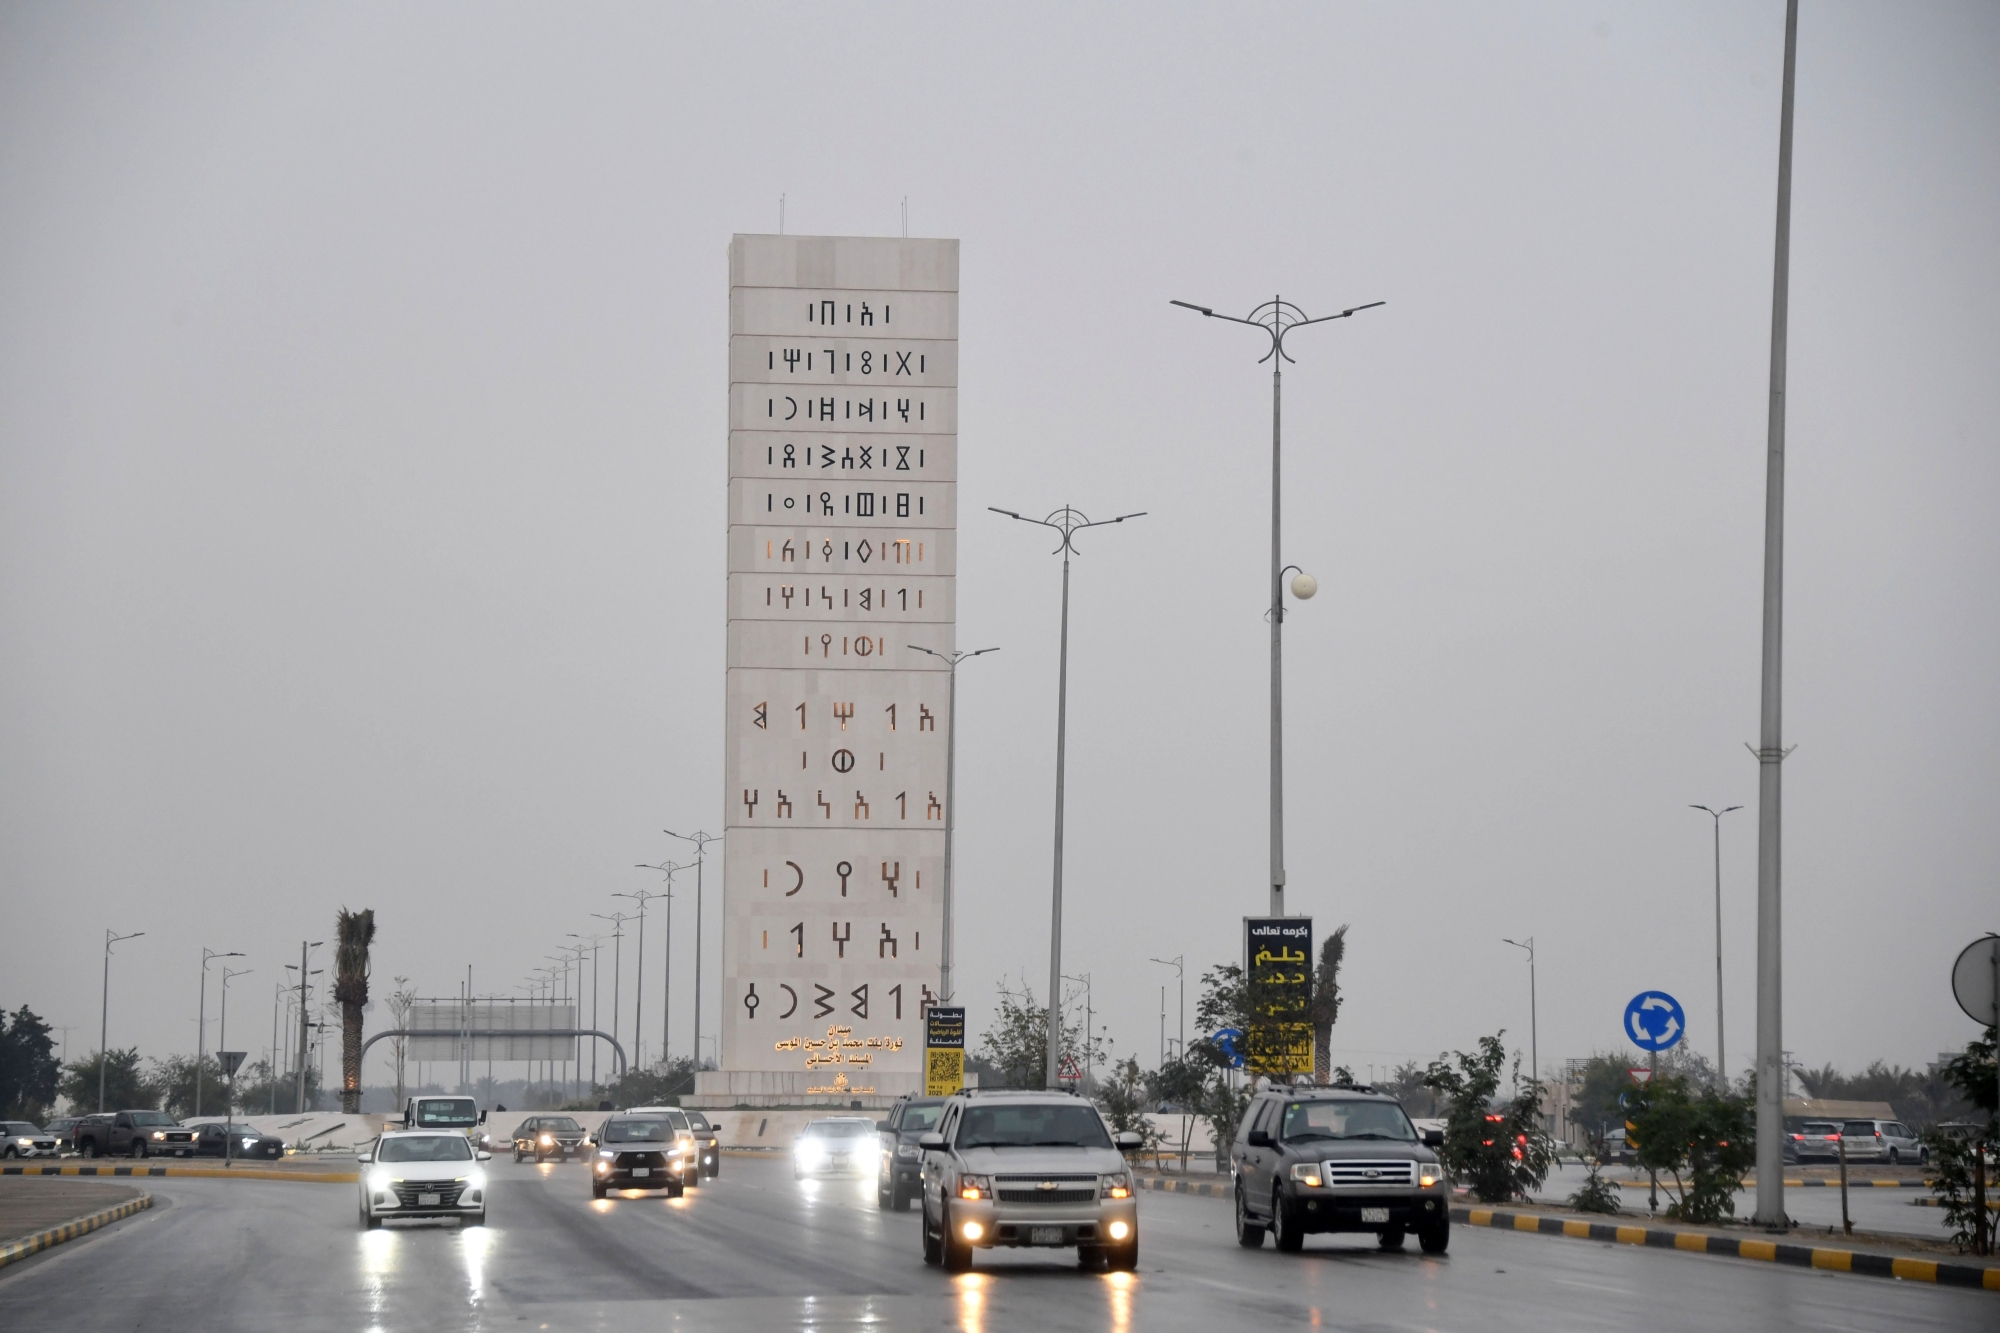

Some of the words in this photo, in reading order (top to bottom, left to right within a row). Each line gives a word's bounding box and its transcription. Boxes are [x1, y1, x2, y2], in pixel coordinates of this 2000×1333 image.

[1252, 925, 1281, 935] تعالى
[1283, 926, 1308, 938] بكرمه
[929, 1011, 963, 1019] بطولة
[827, 1025, 851, 1037] ميدان
[775, 1036, 802, 1051] الموسى
[804, 1036, 826, 1050] حسين
[827, 1037, 840, 1050] بن
[842, 1038, 864, 1048] محمد
[866, 1037, 883, 1050] بنت
[885, 1037, 903, 1051] نورة
[929, 1037, 963, 1045] للمملكة
[848, 1053, 873, 1064] المسند
